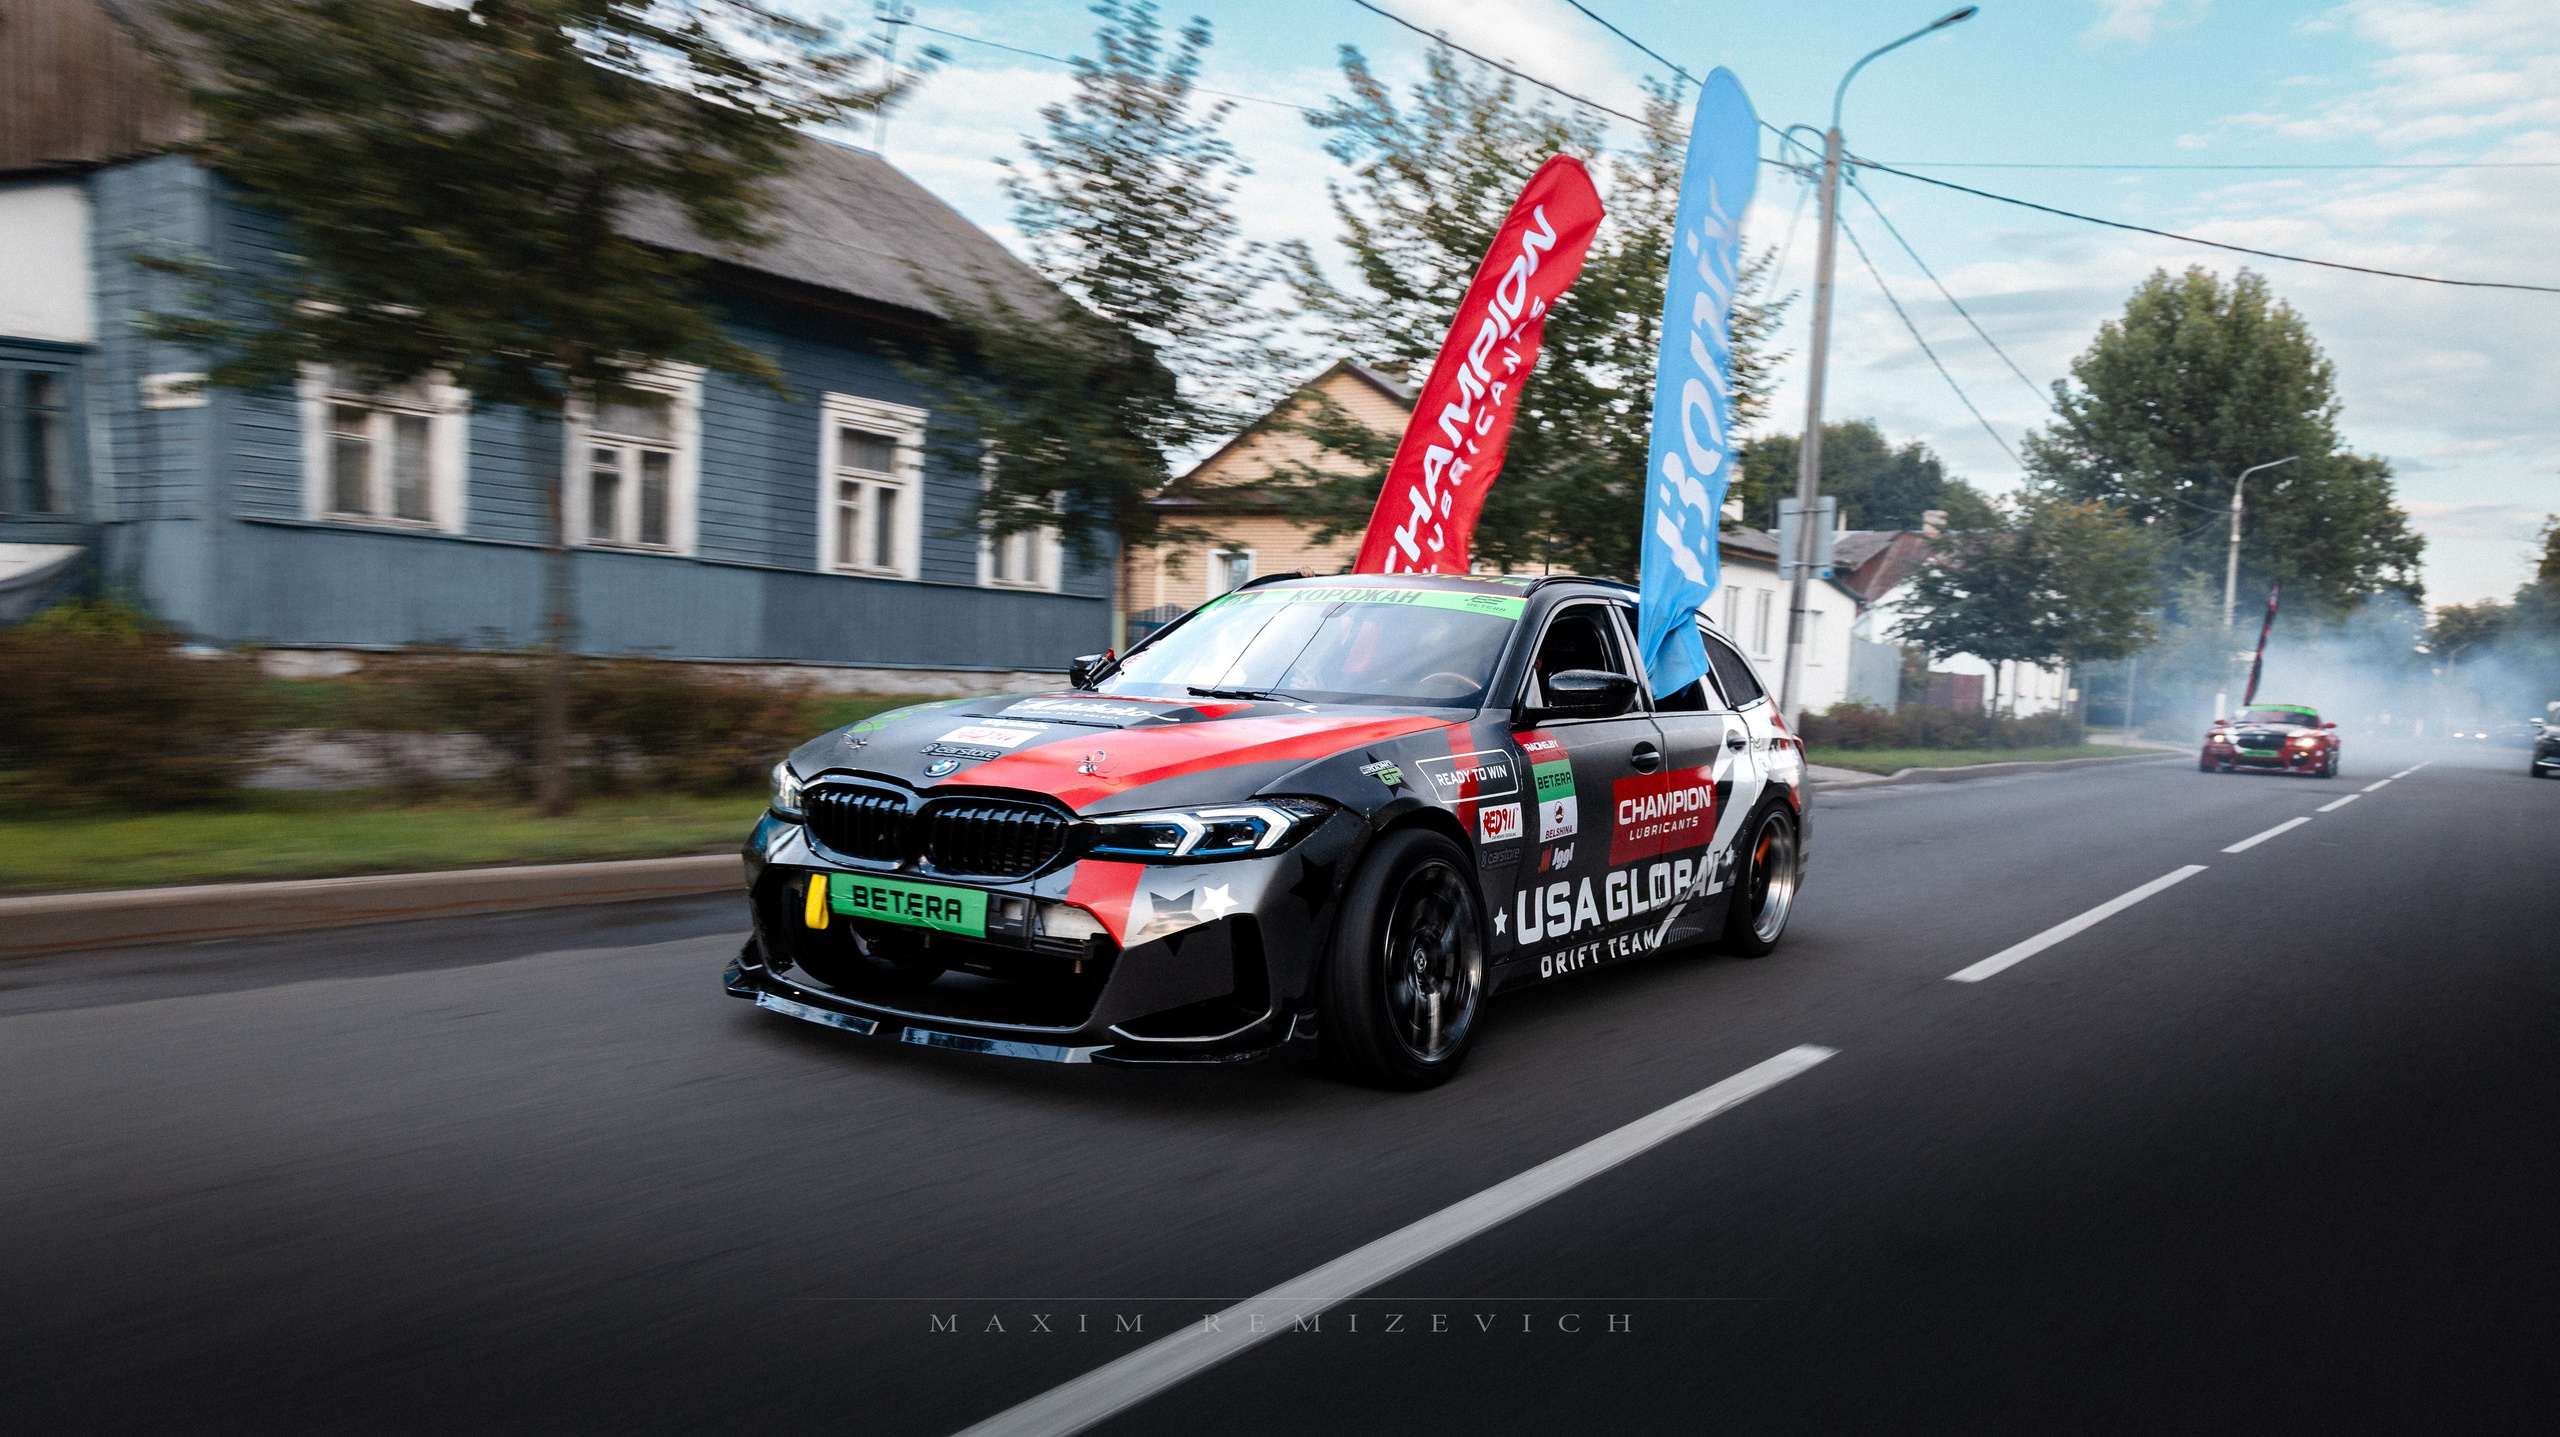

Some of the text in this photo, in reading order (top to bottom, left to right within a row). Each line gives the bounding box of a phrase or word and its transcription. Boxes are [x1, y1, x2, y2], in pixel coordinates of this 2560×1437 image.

[1292, 588, 1423, 604] КОРОЖАН
[935, 745, 1000, 758] carstore
[1435, 765, 1508, 786] READY TO WIN
[1619, 785, 1711, 825] CHAMPION
[1483, 808, 1516, 838] RED911
[1545, 825, 1573, 839] BELSHINA
[1629, 816, 1699, 840] LUBRICANTS
[1488, 848, 1520, 864] carstore
[1516, 850, 1725, 945] USA GLOBAL
[1540, 928, 1655, 978] DRIFT TEAM
